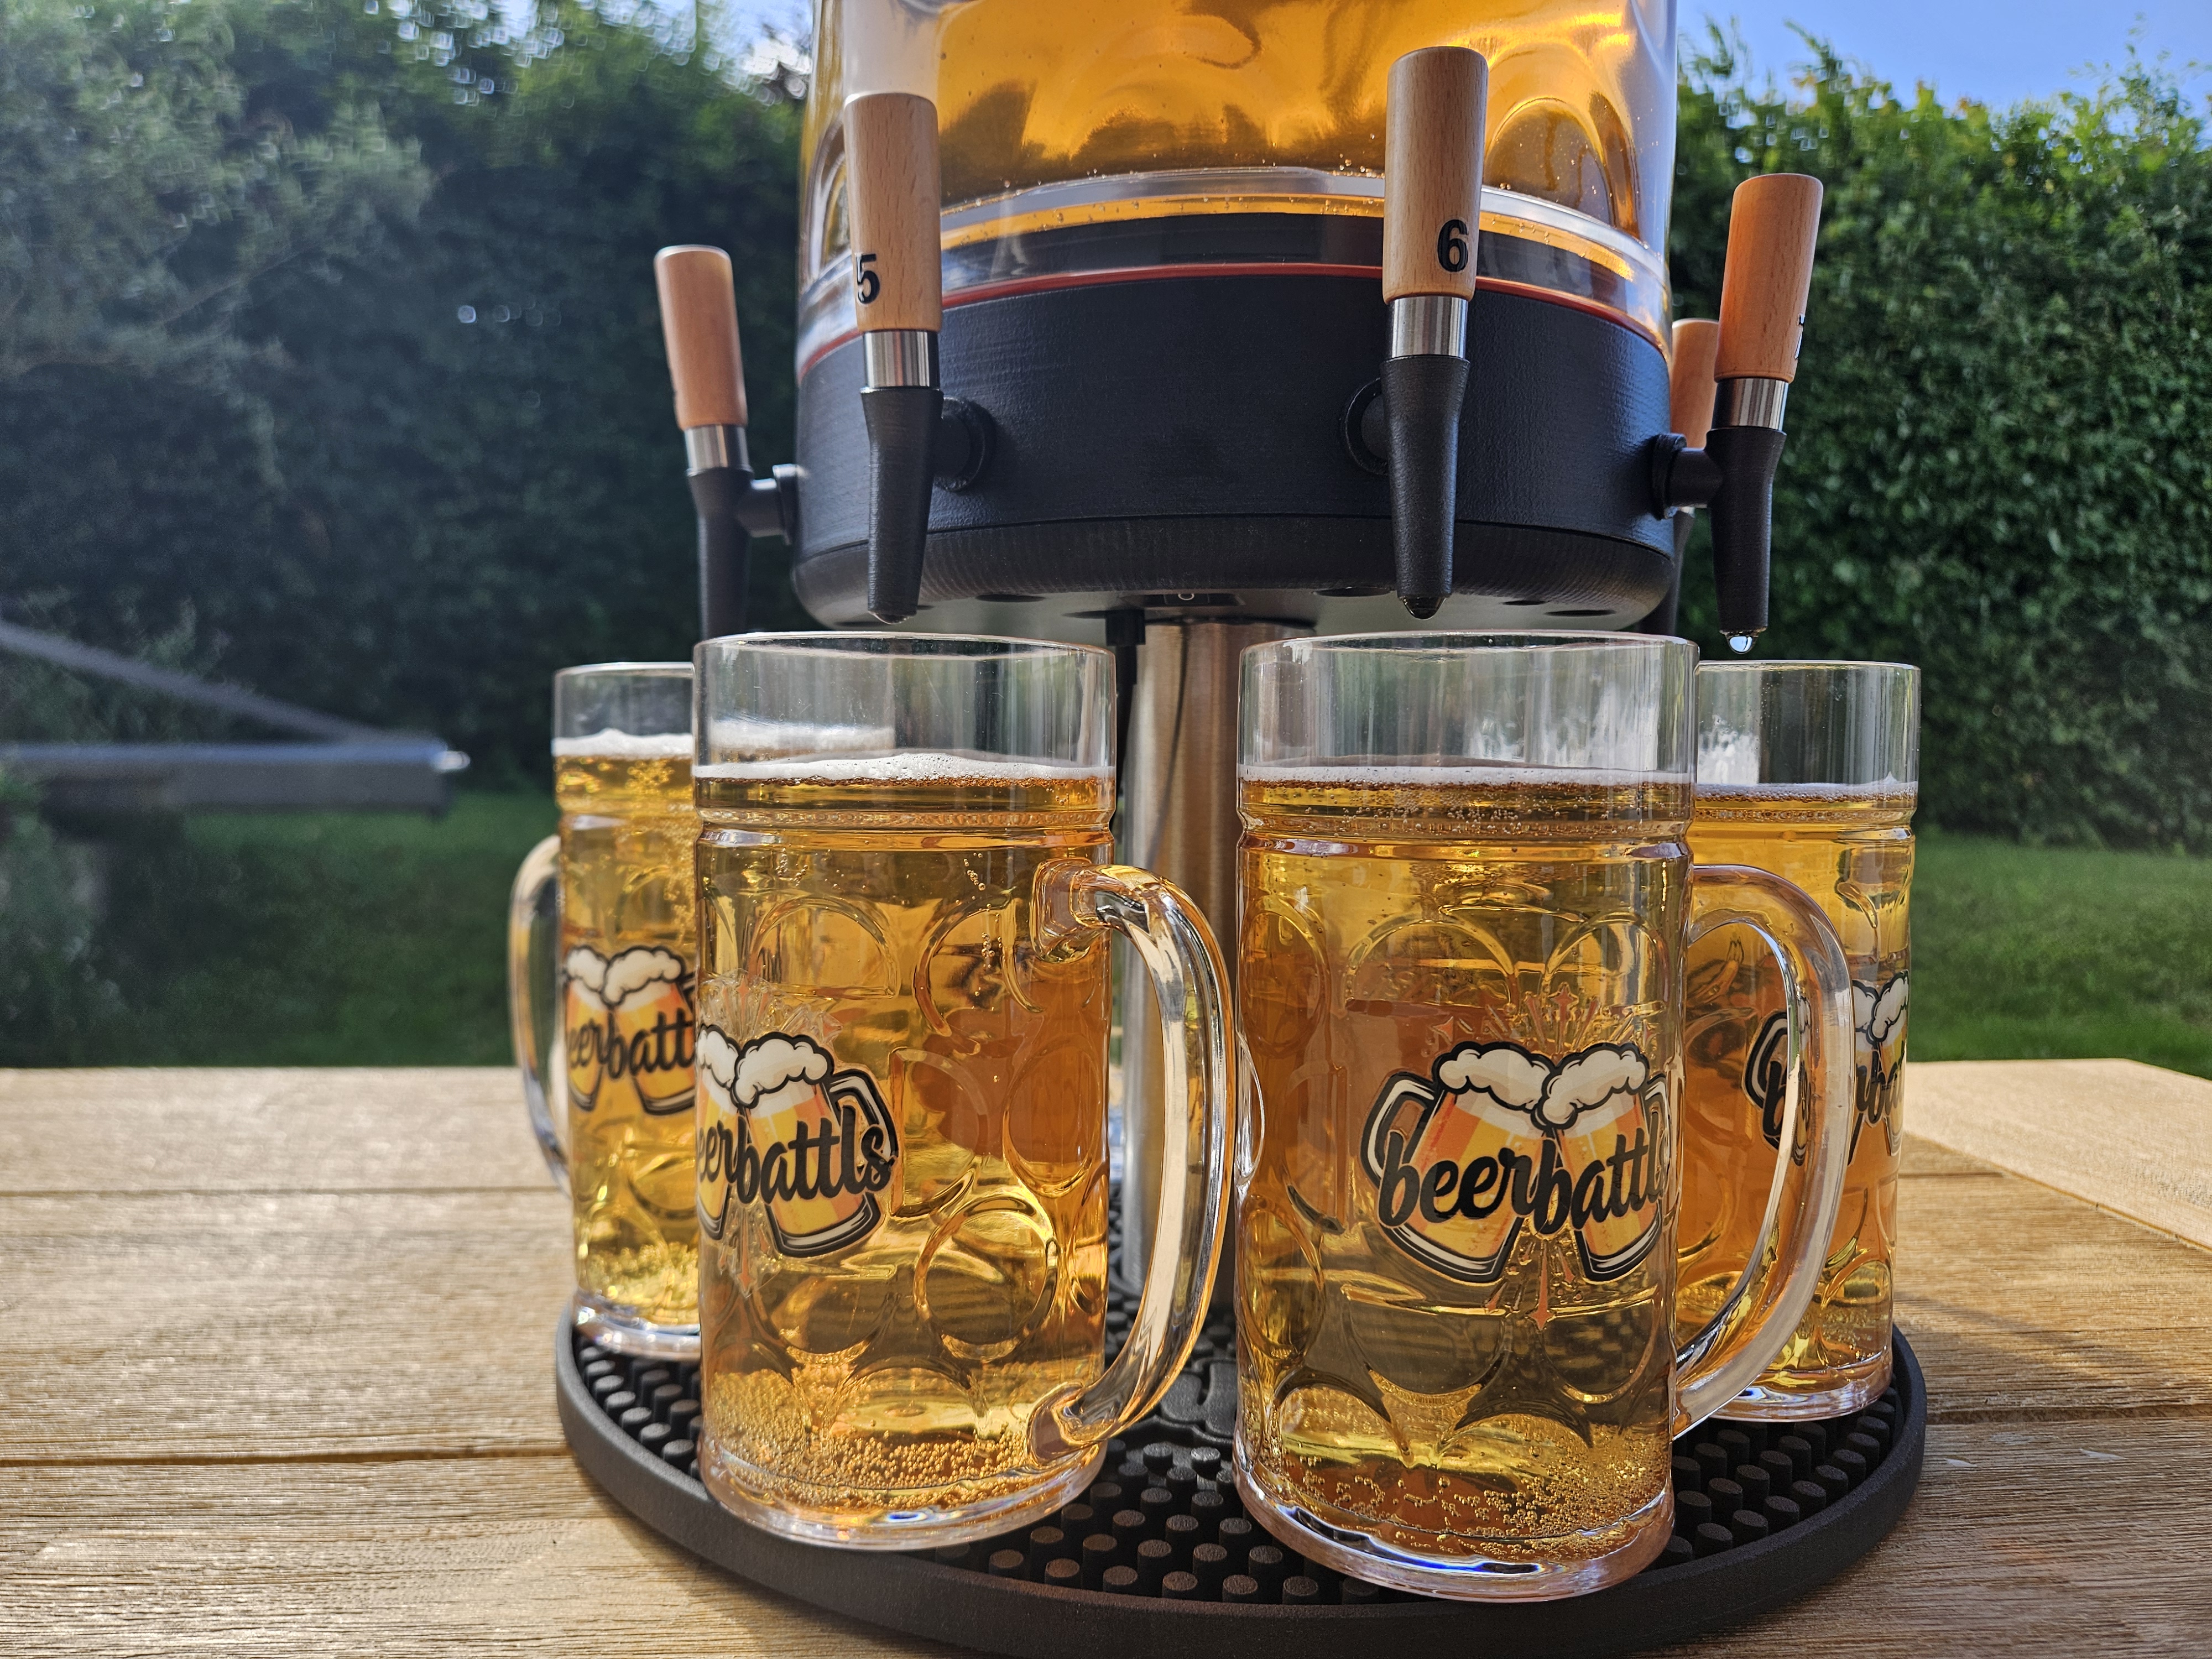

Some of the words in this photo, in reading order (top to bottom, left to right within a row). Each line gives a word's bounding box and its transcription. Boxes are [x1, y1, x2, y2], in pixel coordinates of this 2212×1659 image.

[855, 253, 880, 305] 5
[1437, 218, 1469, 272] 6
[697, 1104, 895, 1204] eerbattls
[1378, 1112, 1663, 1235] beerbattl
